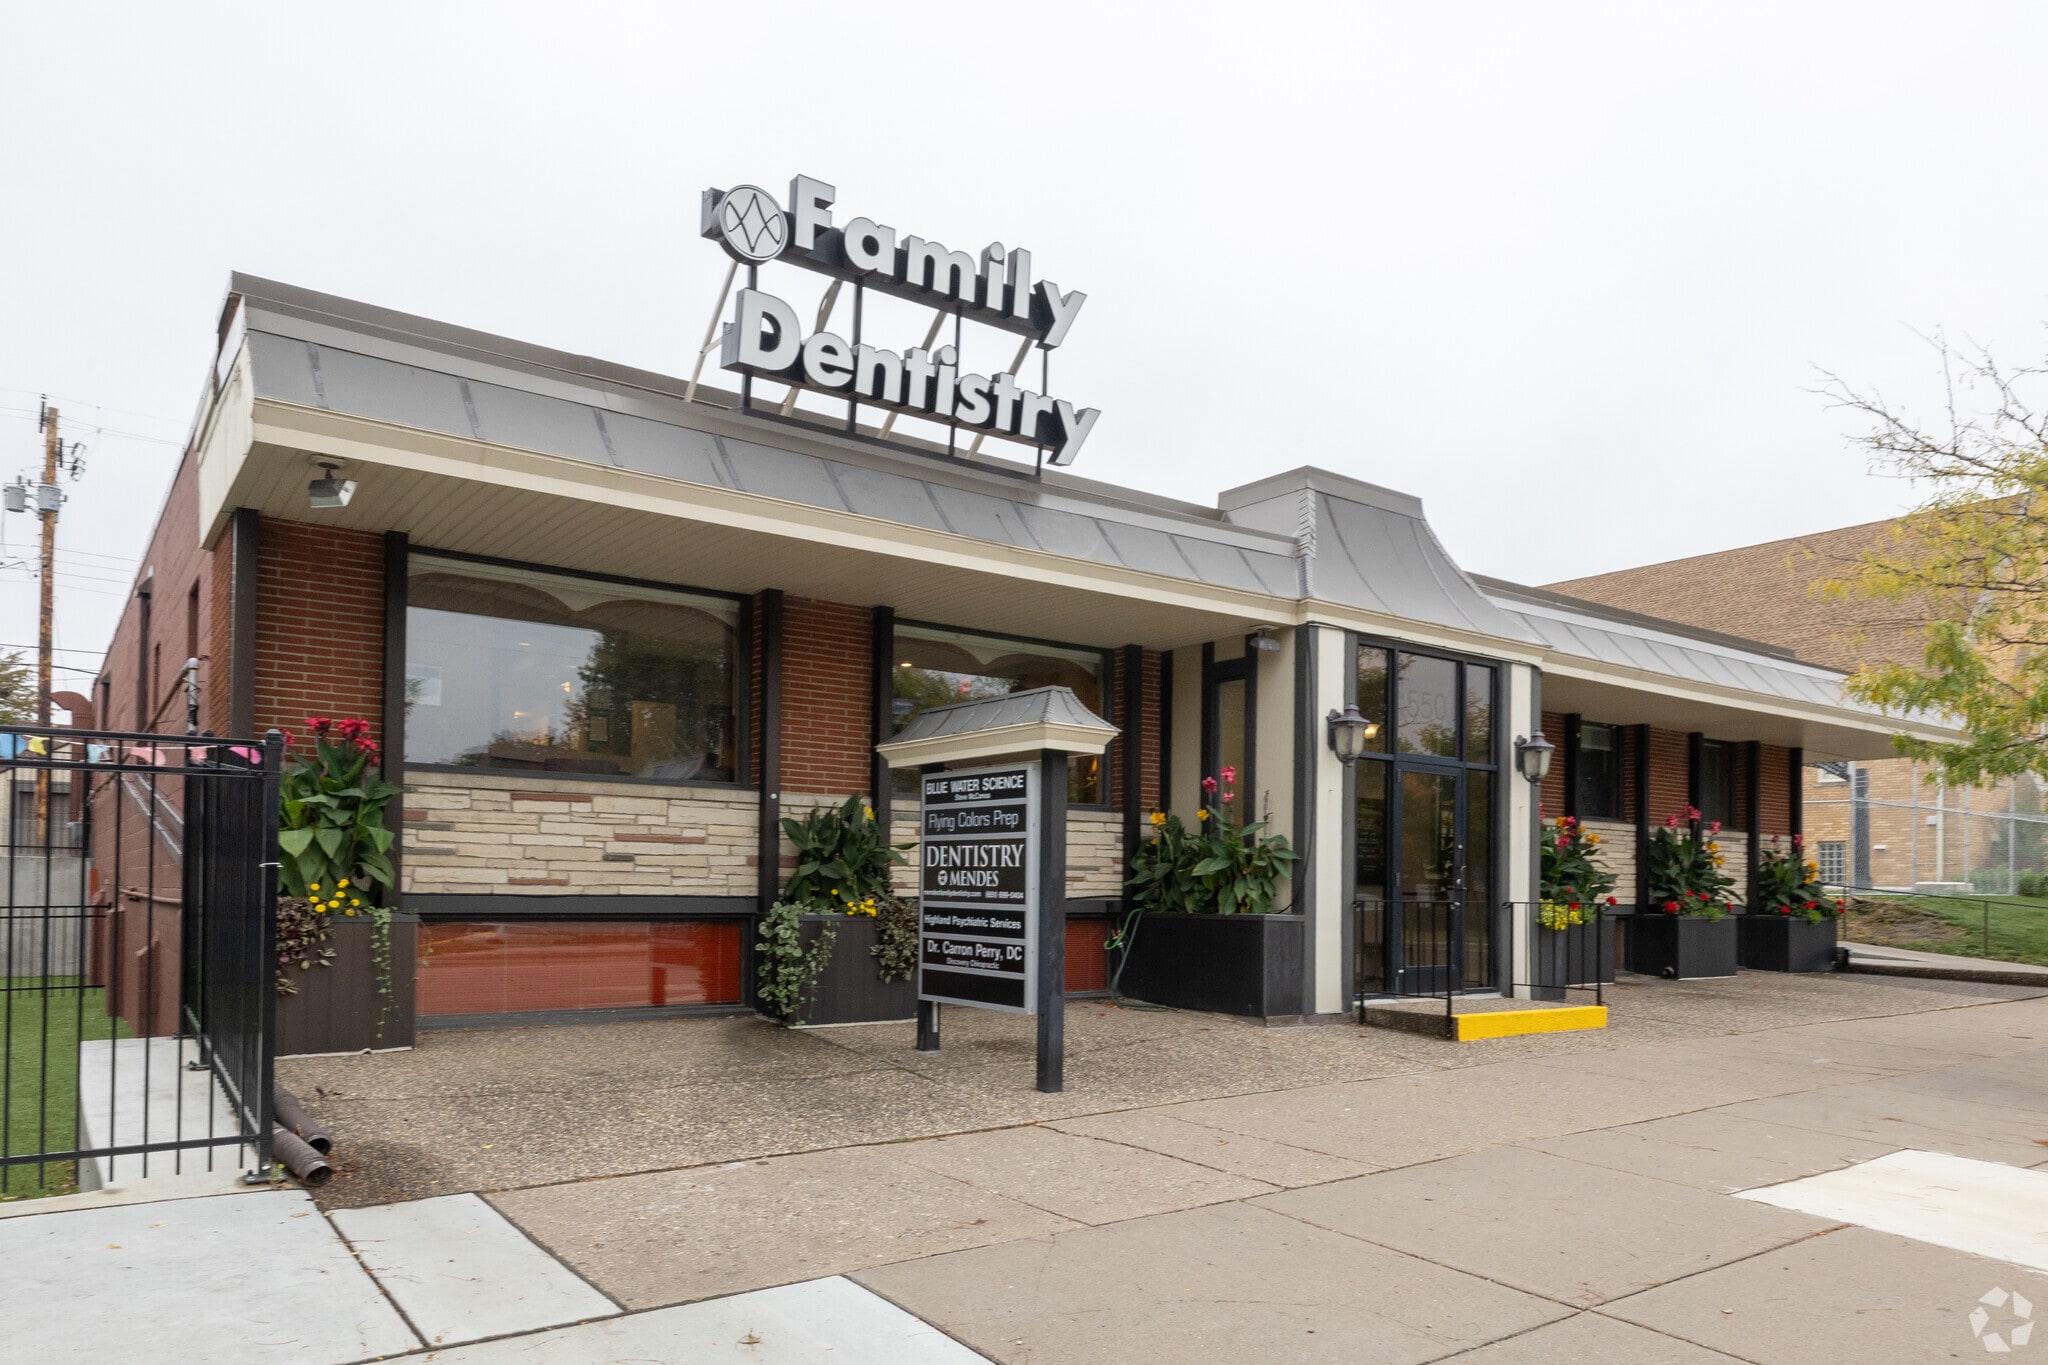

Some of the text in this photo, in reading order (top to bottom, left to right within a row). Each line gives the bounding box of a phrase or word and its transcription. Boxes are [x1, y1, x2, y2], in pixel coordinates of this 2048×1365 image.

[789, 174, 1088, 350] Family
[733, 286, 1102, 466] Dentistry
[926, 775, 1024, 794] BLUE WATER SCIENCE
[928, 810, 1018, 831] Flying Colors Prep
[926, 844, 1024, 867] DENTISTRY
[949, 870, 1000, 887] MENDES
[924, 915, 1021, 929] Highland Psychiatric Services
[927, 940, 1022, 961] Dr. Carron Perry, DC
